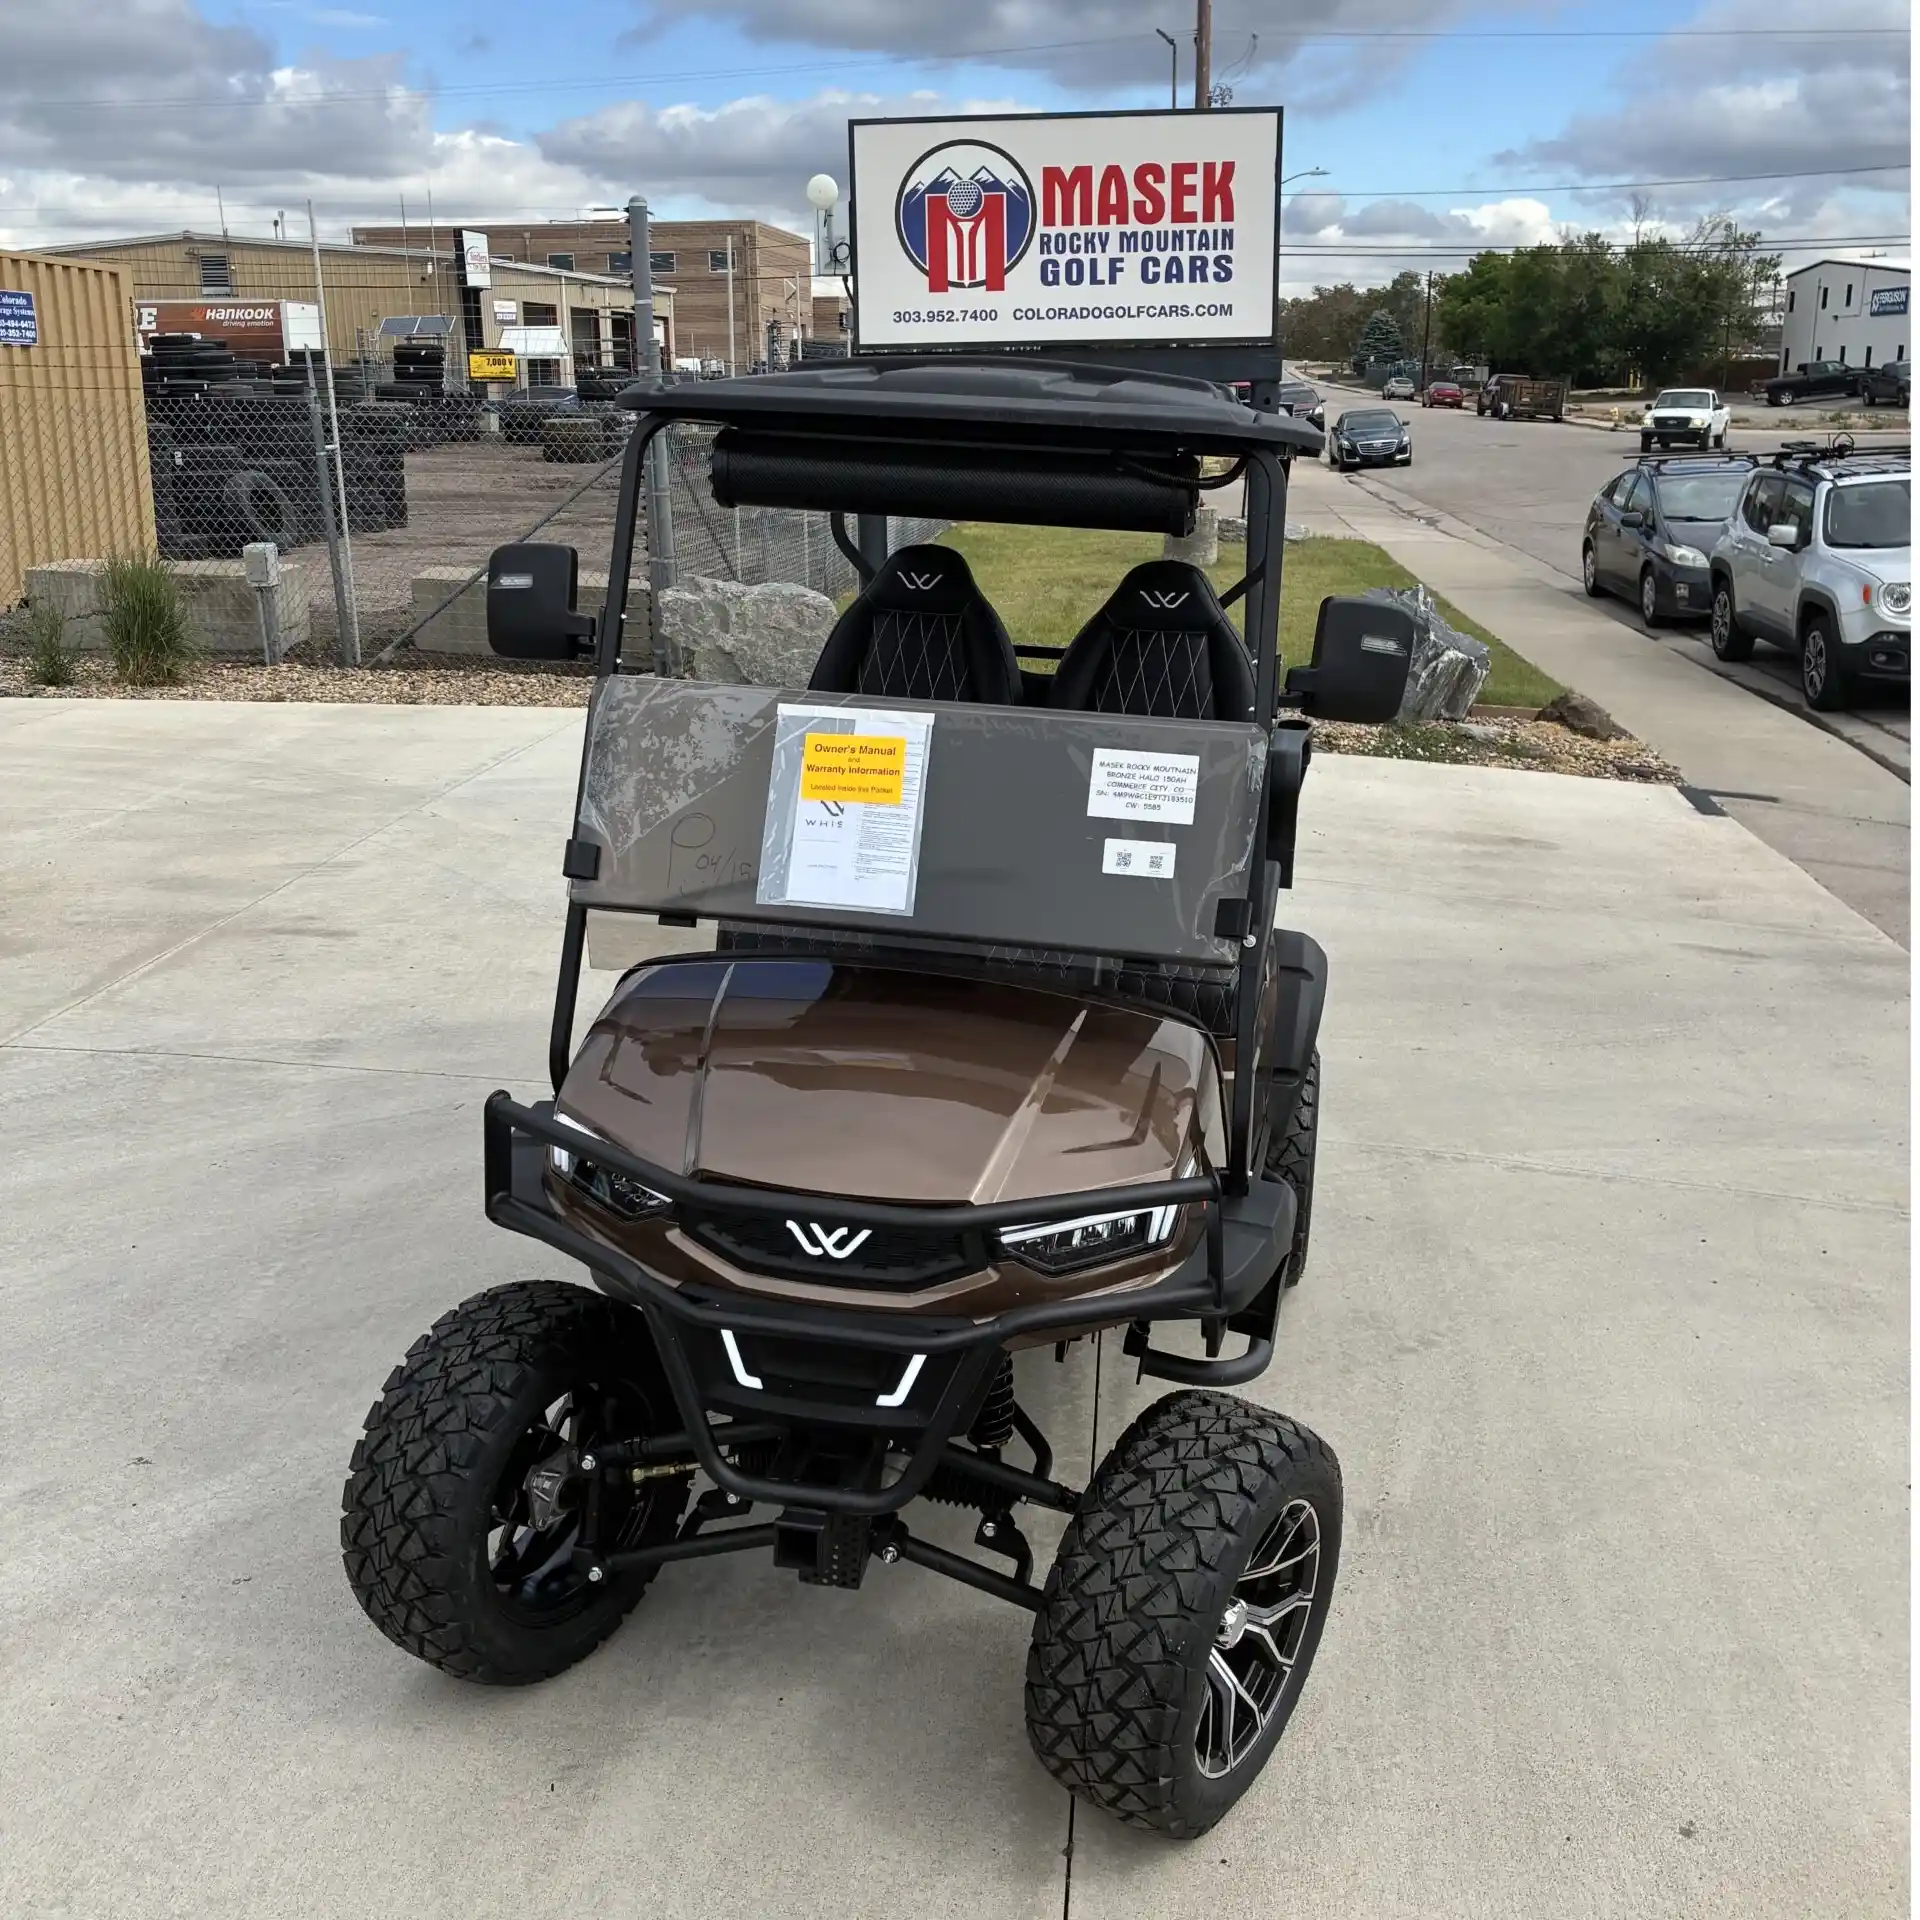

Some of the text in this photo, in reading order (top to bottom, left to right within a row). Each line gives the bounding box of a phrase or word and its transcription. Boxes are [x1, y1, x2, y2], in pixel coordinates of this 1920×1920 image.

[1042, 160, 1235, 227] MASEK
[1039, 229, 1234, 255] ROCKY MOUNTAIN
[1039, 255, 1233, 287] GOLF CARS
[893, 303, 1233, 324] 303.952.7400 COLORADOGOLFCARS.COM
[222, 320, 246, 328] driving
[814, 743, 897, 756] Owner's Manual
[806, 764, 900, 776] Warranty Information
[1098, 761, 1124, 769] MASEK
[1126, 763, 1151, 771] ROCKY
[1106, 771, 1137, 780] BRONZE
[1139, 774, 1160, 782] HALO
[871, 786, 893, 794] Packet
[1106, 781, 1147, 790] COMMERCE
